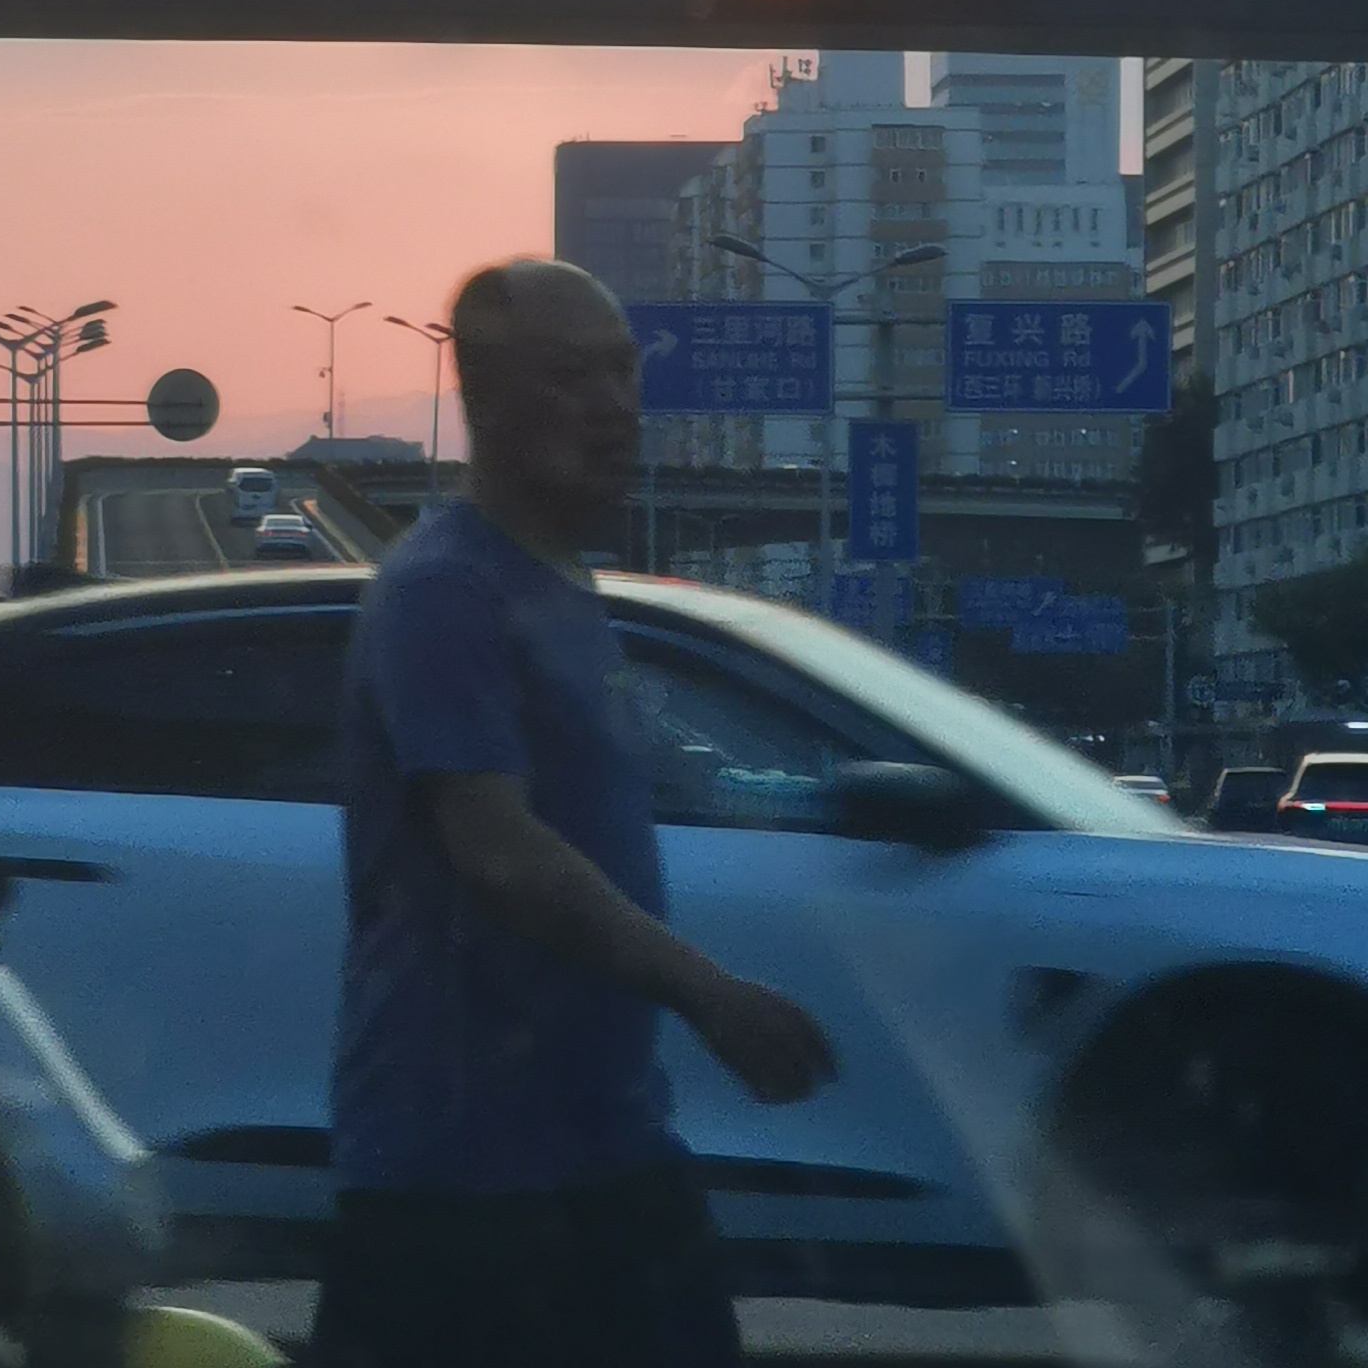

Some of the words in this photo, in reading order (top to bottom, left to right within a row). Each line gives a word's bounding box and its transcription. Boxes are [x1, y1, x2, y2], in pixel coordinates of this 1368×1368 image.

[690, 315, 816, 347] 三里河路
[964, 312, 1093, 345] 复兴路
[963, 350, 1050, 367] FUXING
[1062, 350, 1091, 367] Rd
